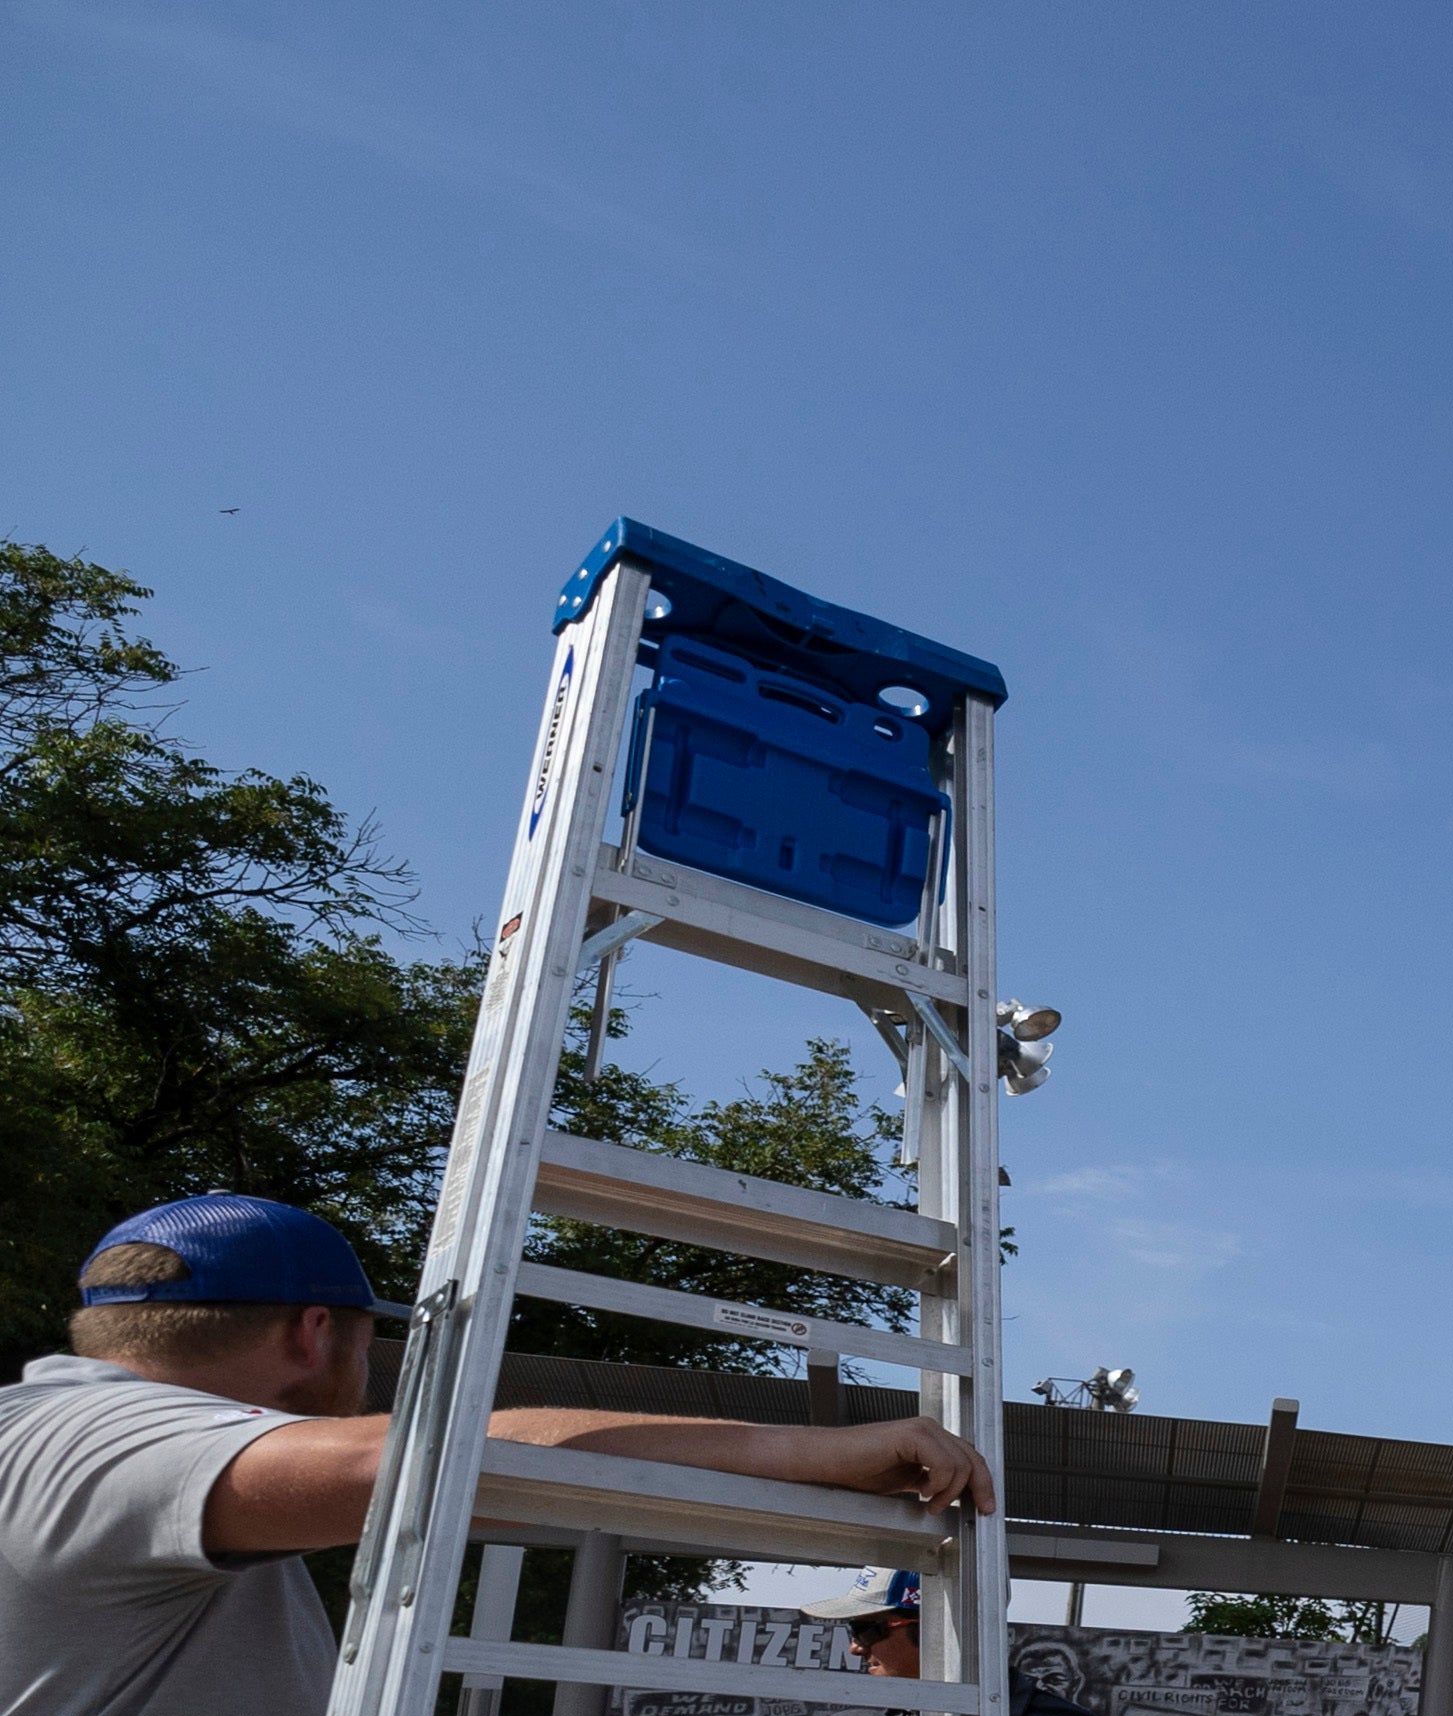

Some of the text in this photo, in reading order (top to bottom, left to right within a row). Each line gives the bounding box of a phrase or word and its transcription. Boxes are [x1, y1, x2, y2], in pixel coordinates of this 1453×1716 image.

[536, 686, 567, 800] WERNER
[628, 1613, 864, 1671] CITIZEN
[670, 1692, 717, 1704] WE
[1117, 1688, 1213, 1704] CIVIL RIGHTS
[639, 1702, 748, 1716] DEMAND
[1217, 1698, 1249, 1710] FOR
